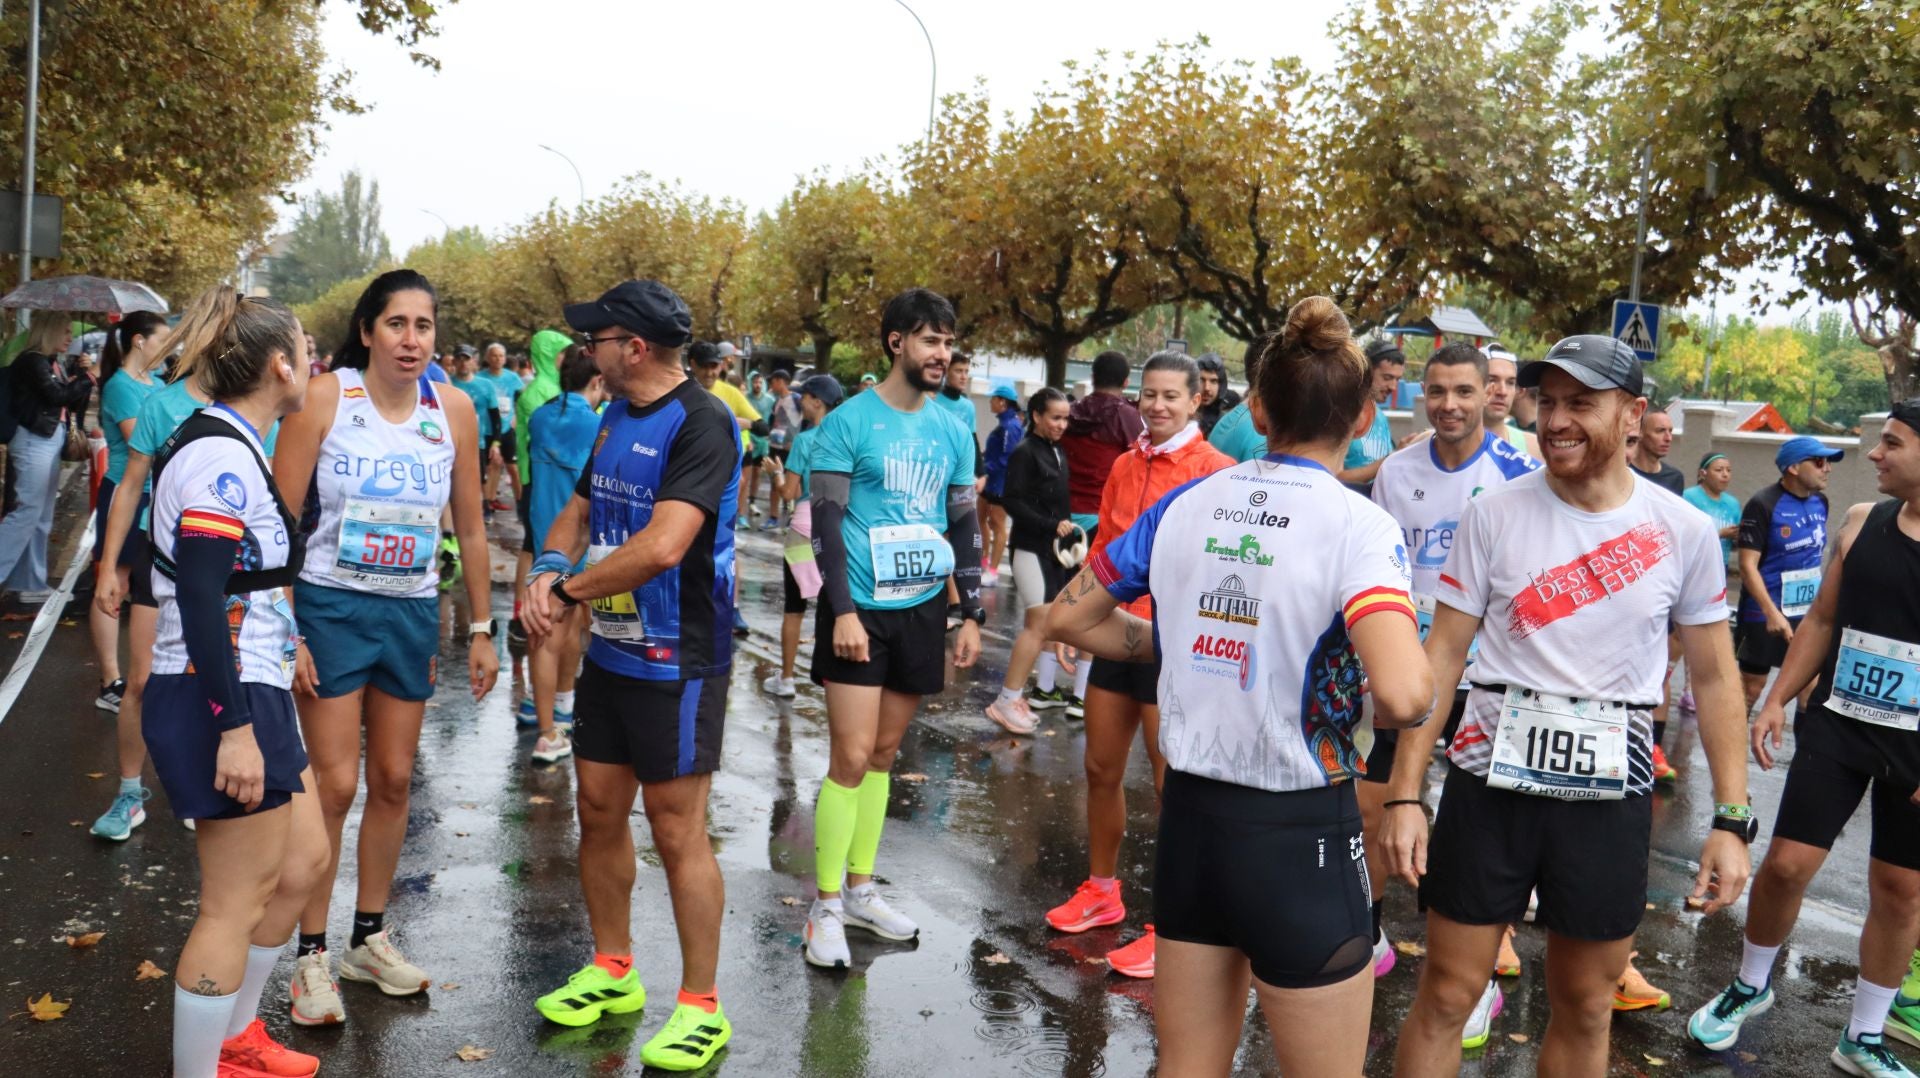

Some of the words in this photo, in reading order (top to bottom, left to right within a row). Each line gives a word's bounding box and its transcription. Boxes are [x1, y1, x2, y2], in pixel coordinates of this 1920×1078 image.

[1491, 437, 1537, 470] C.A.
[1213, 508, 1290, 529] evolutea
[362, 533, 416, 567] 588
[894, 550, 935, 578] 662
[1536, 540, 1642, 604] DESPENSA
[371, 577, 413, 585] HYUNDAI
[1569, 585, 1596, 606] DE
[1192, 634, 1245, 661] ALCOS
[1849, 661, 1904, 703] 592
[1854, 706, 1901, 721] HYUNDAI
[1526, 726, 1597, 776] 1195
[1539, 787, 1600, 799] HYUNDAI
